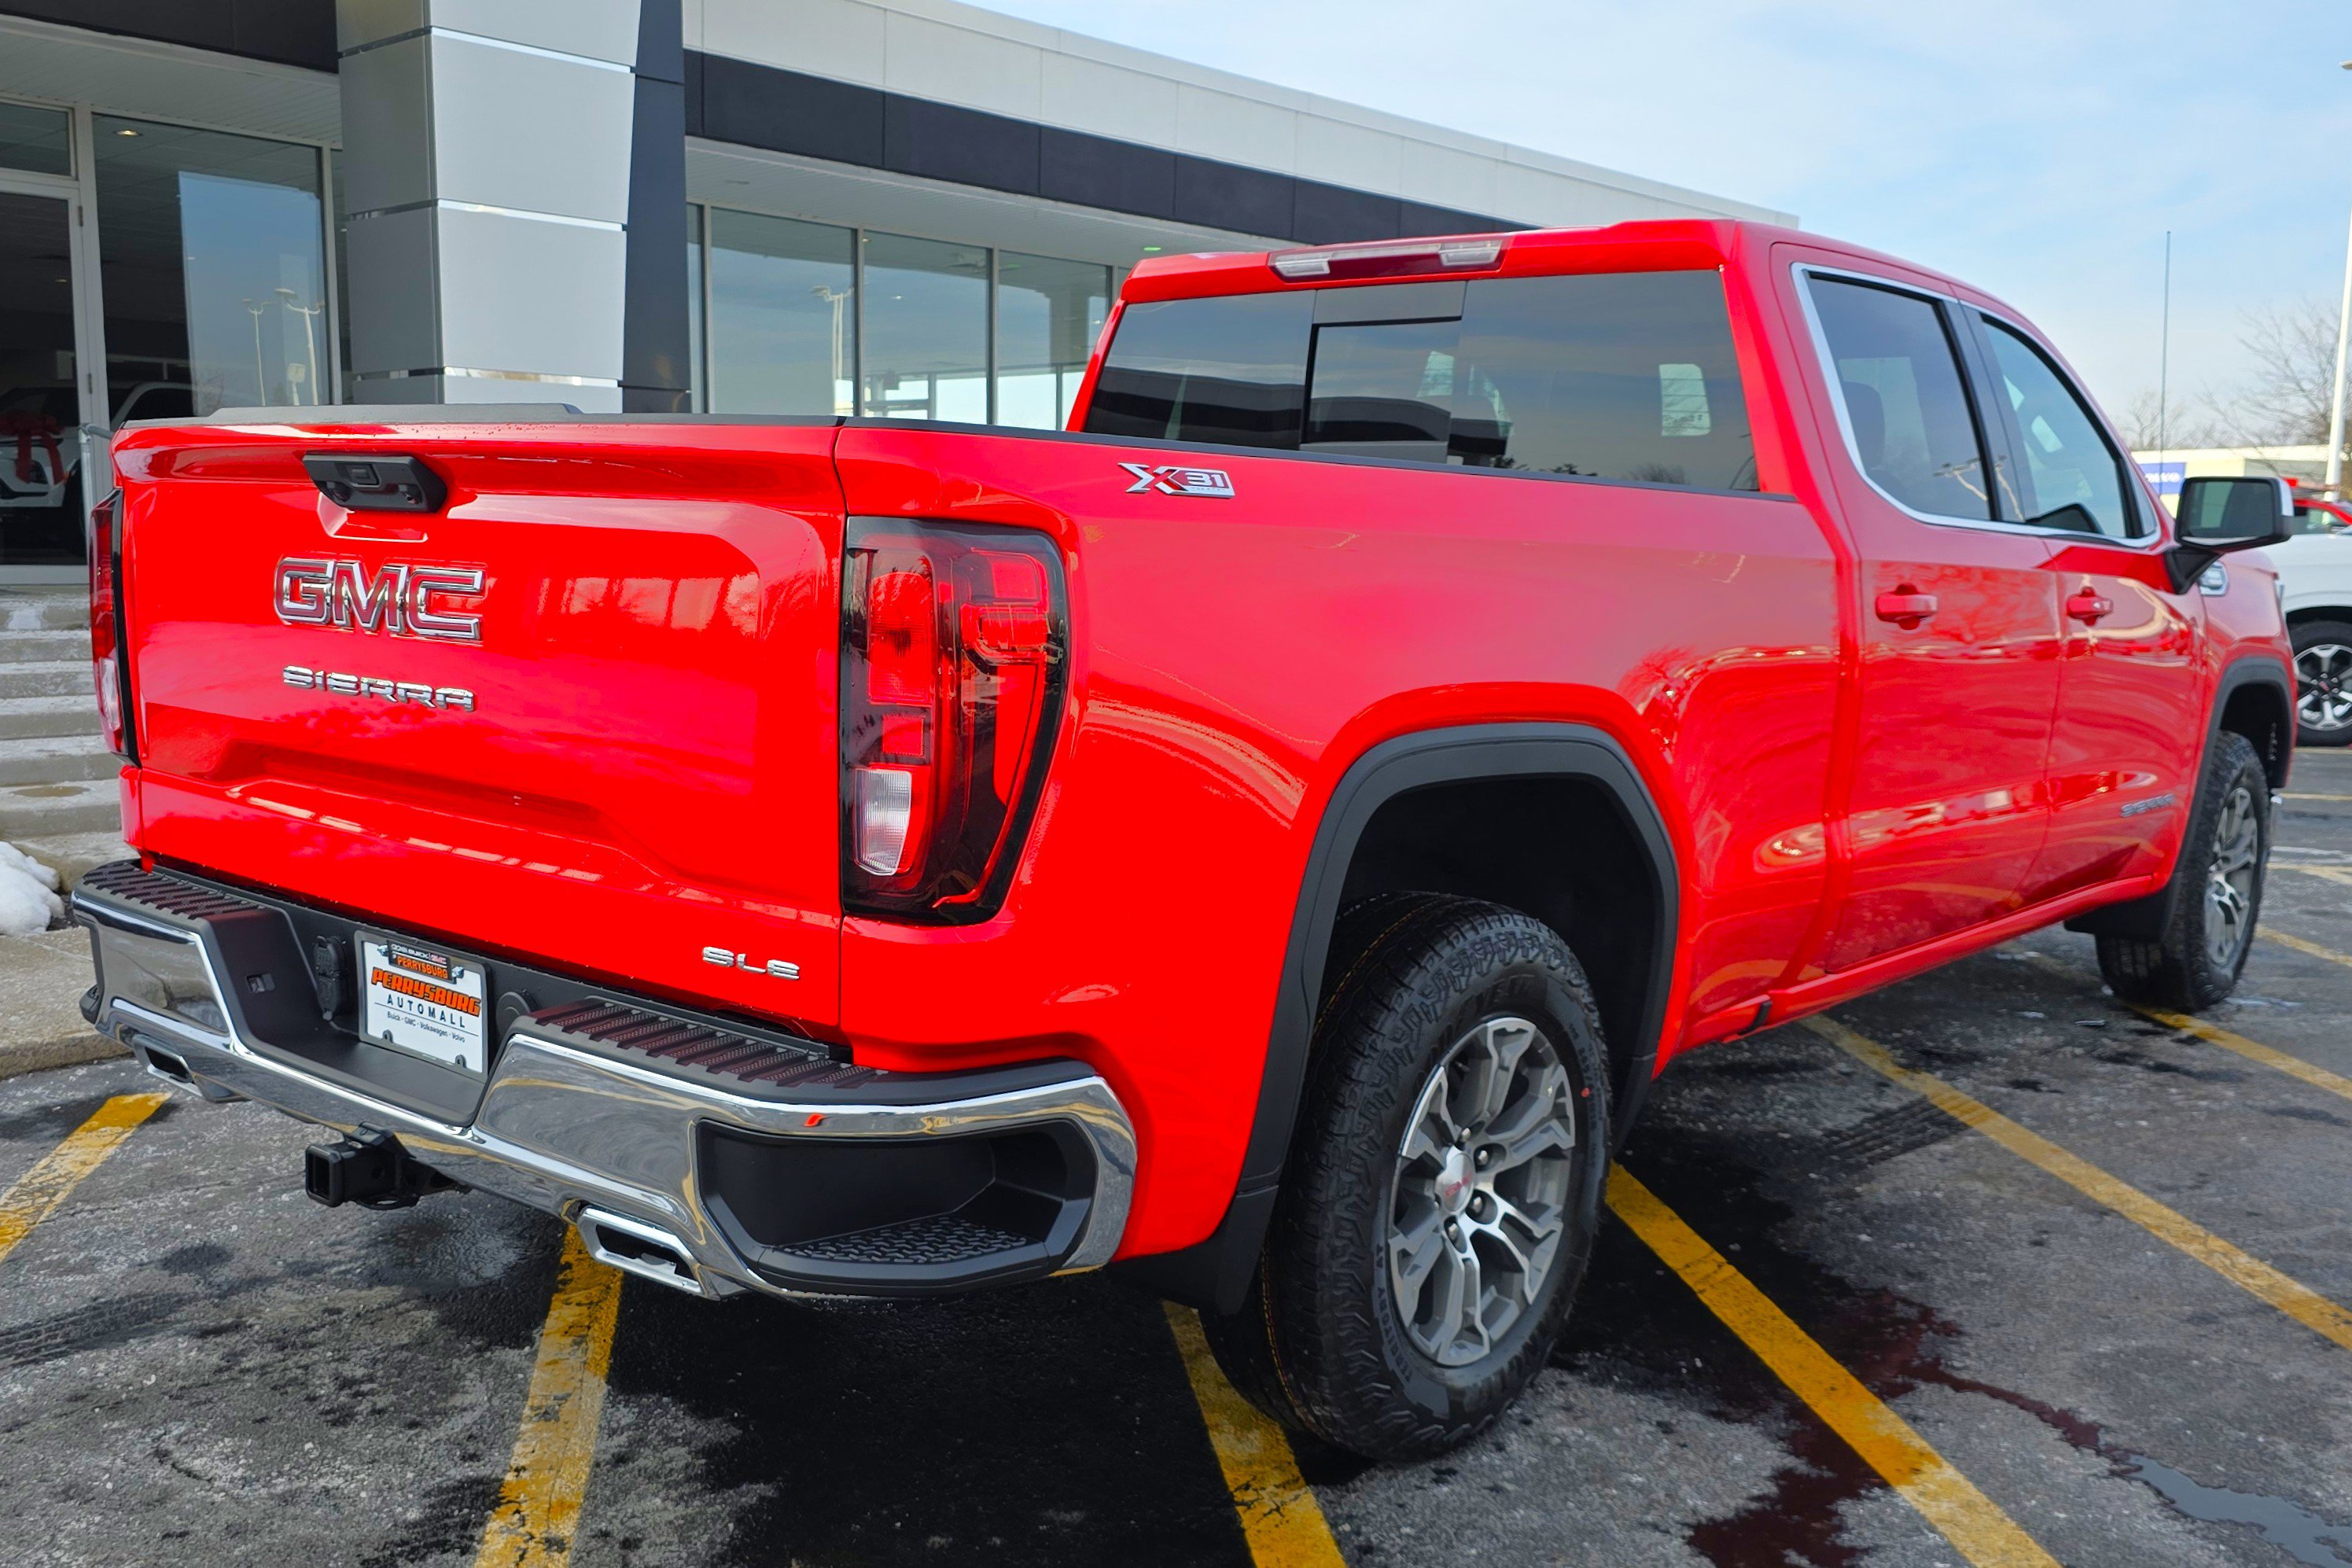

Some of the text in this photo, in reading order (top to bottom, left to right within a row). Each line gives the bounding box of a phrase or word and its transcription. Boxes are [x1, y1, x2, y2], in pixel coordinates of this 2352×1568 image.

[274, 558, 485, 641] GMC
[283, 666, 476, 712] SIERRA
[396, 955, 449, 979] PERRYSBURG
[702, 946, 800, 981] SLE
[371, 966, 482, 1017] PERRYSBURG
[387, 994, 466, 1029] AUTOMALL
[1377, 1286, 1413, 1383] TERRITORY
